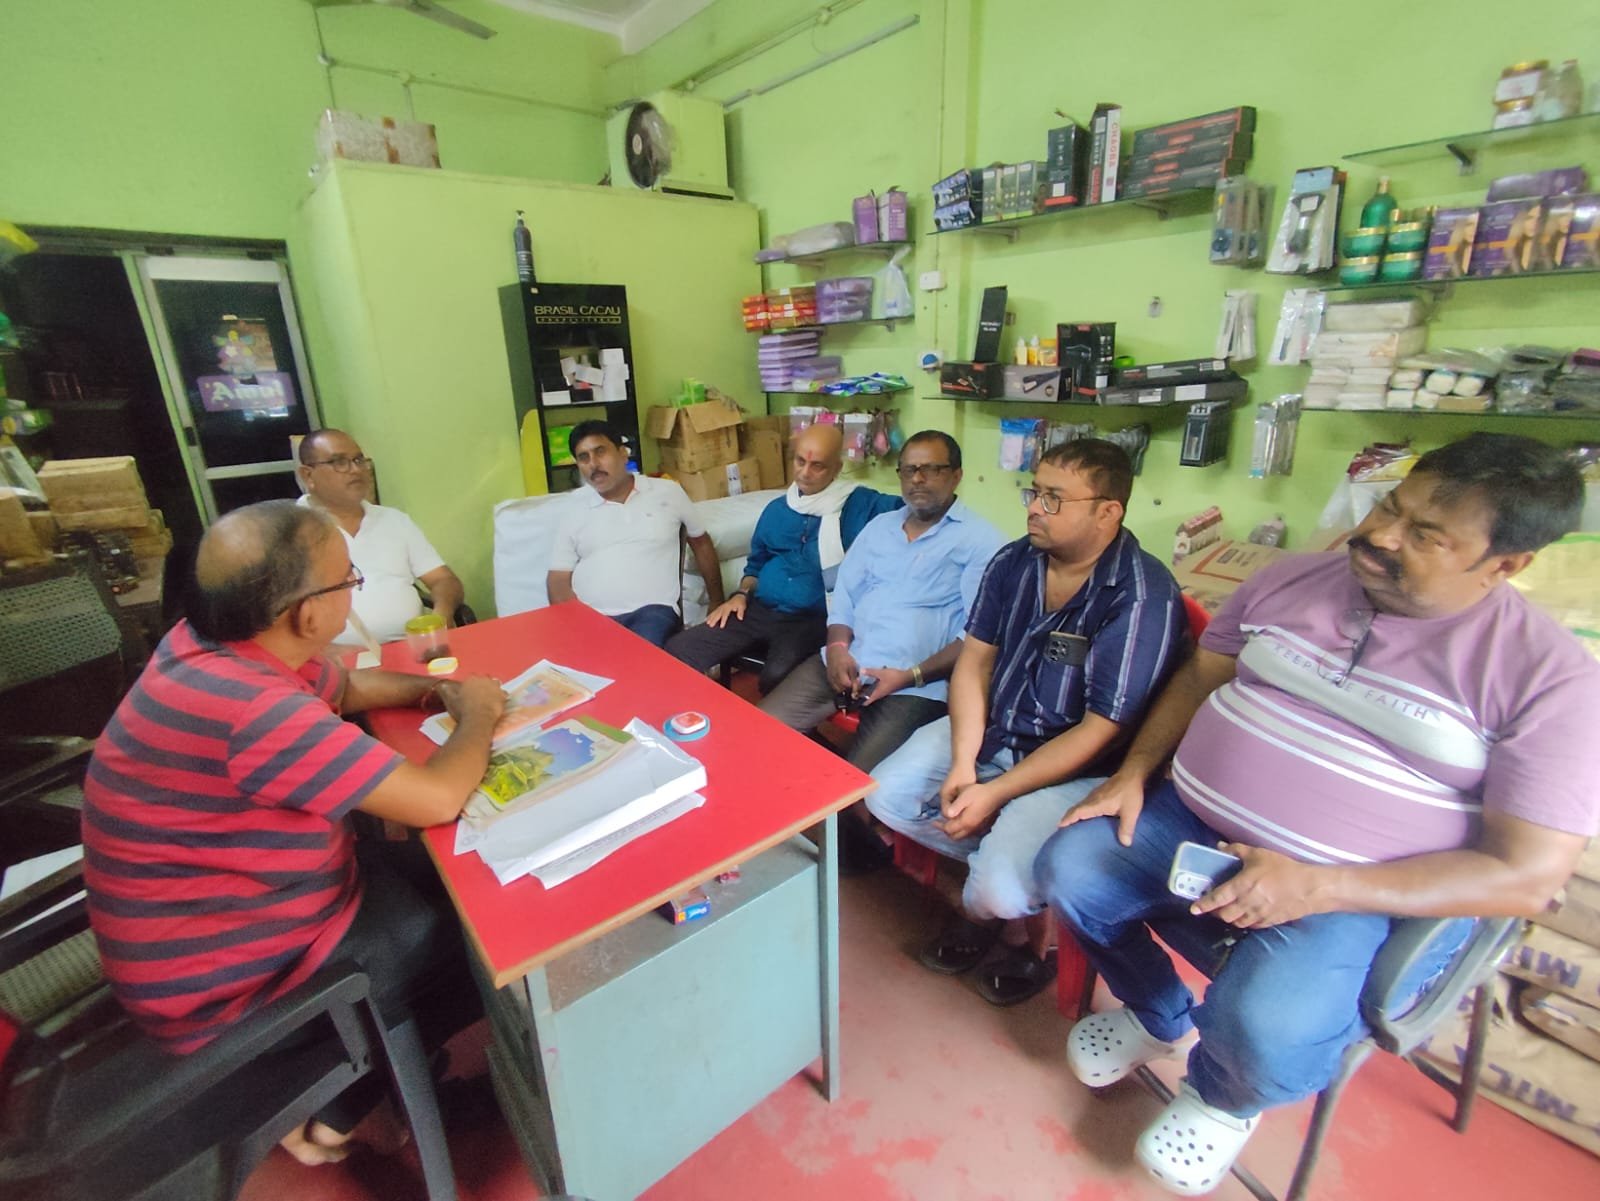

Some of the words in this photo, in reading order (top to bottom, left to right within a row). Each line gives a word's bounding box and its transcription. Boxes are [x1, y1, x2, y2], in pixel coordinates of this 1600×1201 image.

[534, 305, 578, 315] BRASIL
[580, 305, 621, 315] CACAU
[1275, 643, 1312, 668] KEEP
[1364, 690, 1428, 720] FAITH
